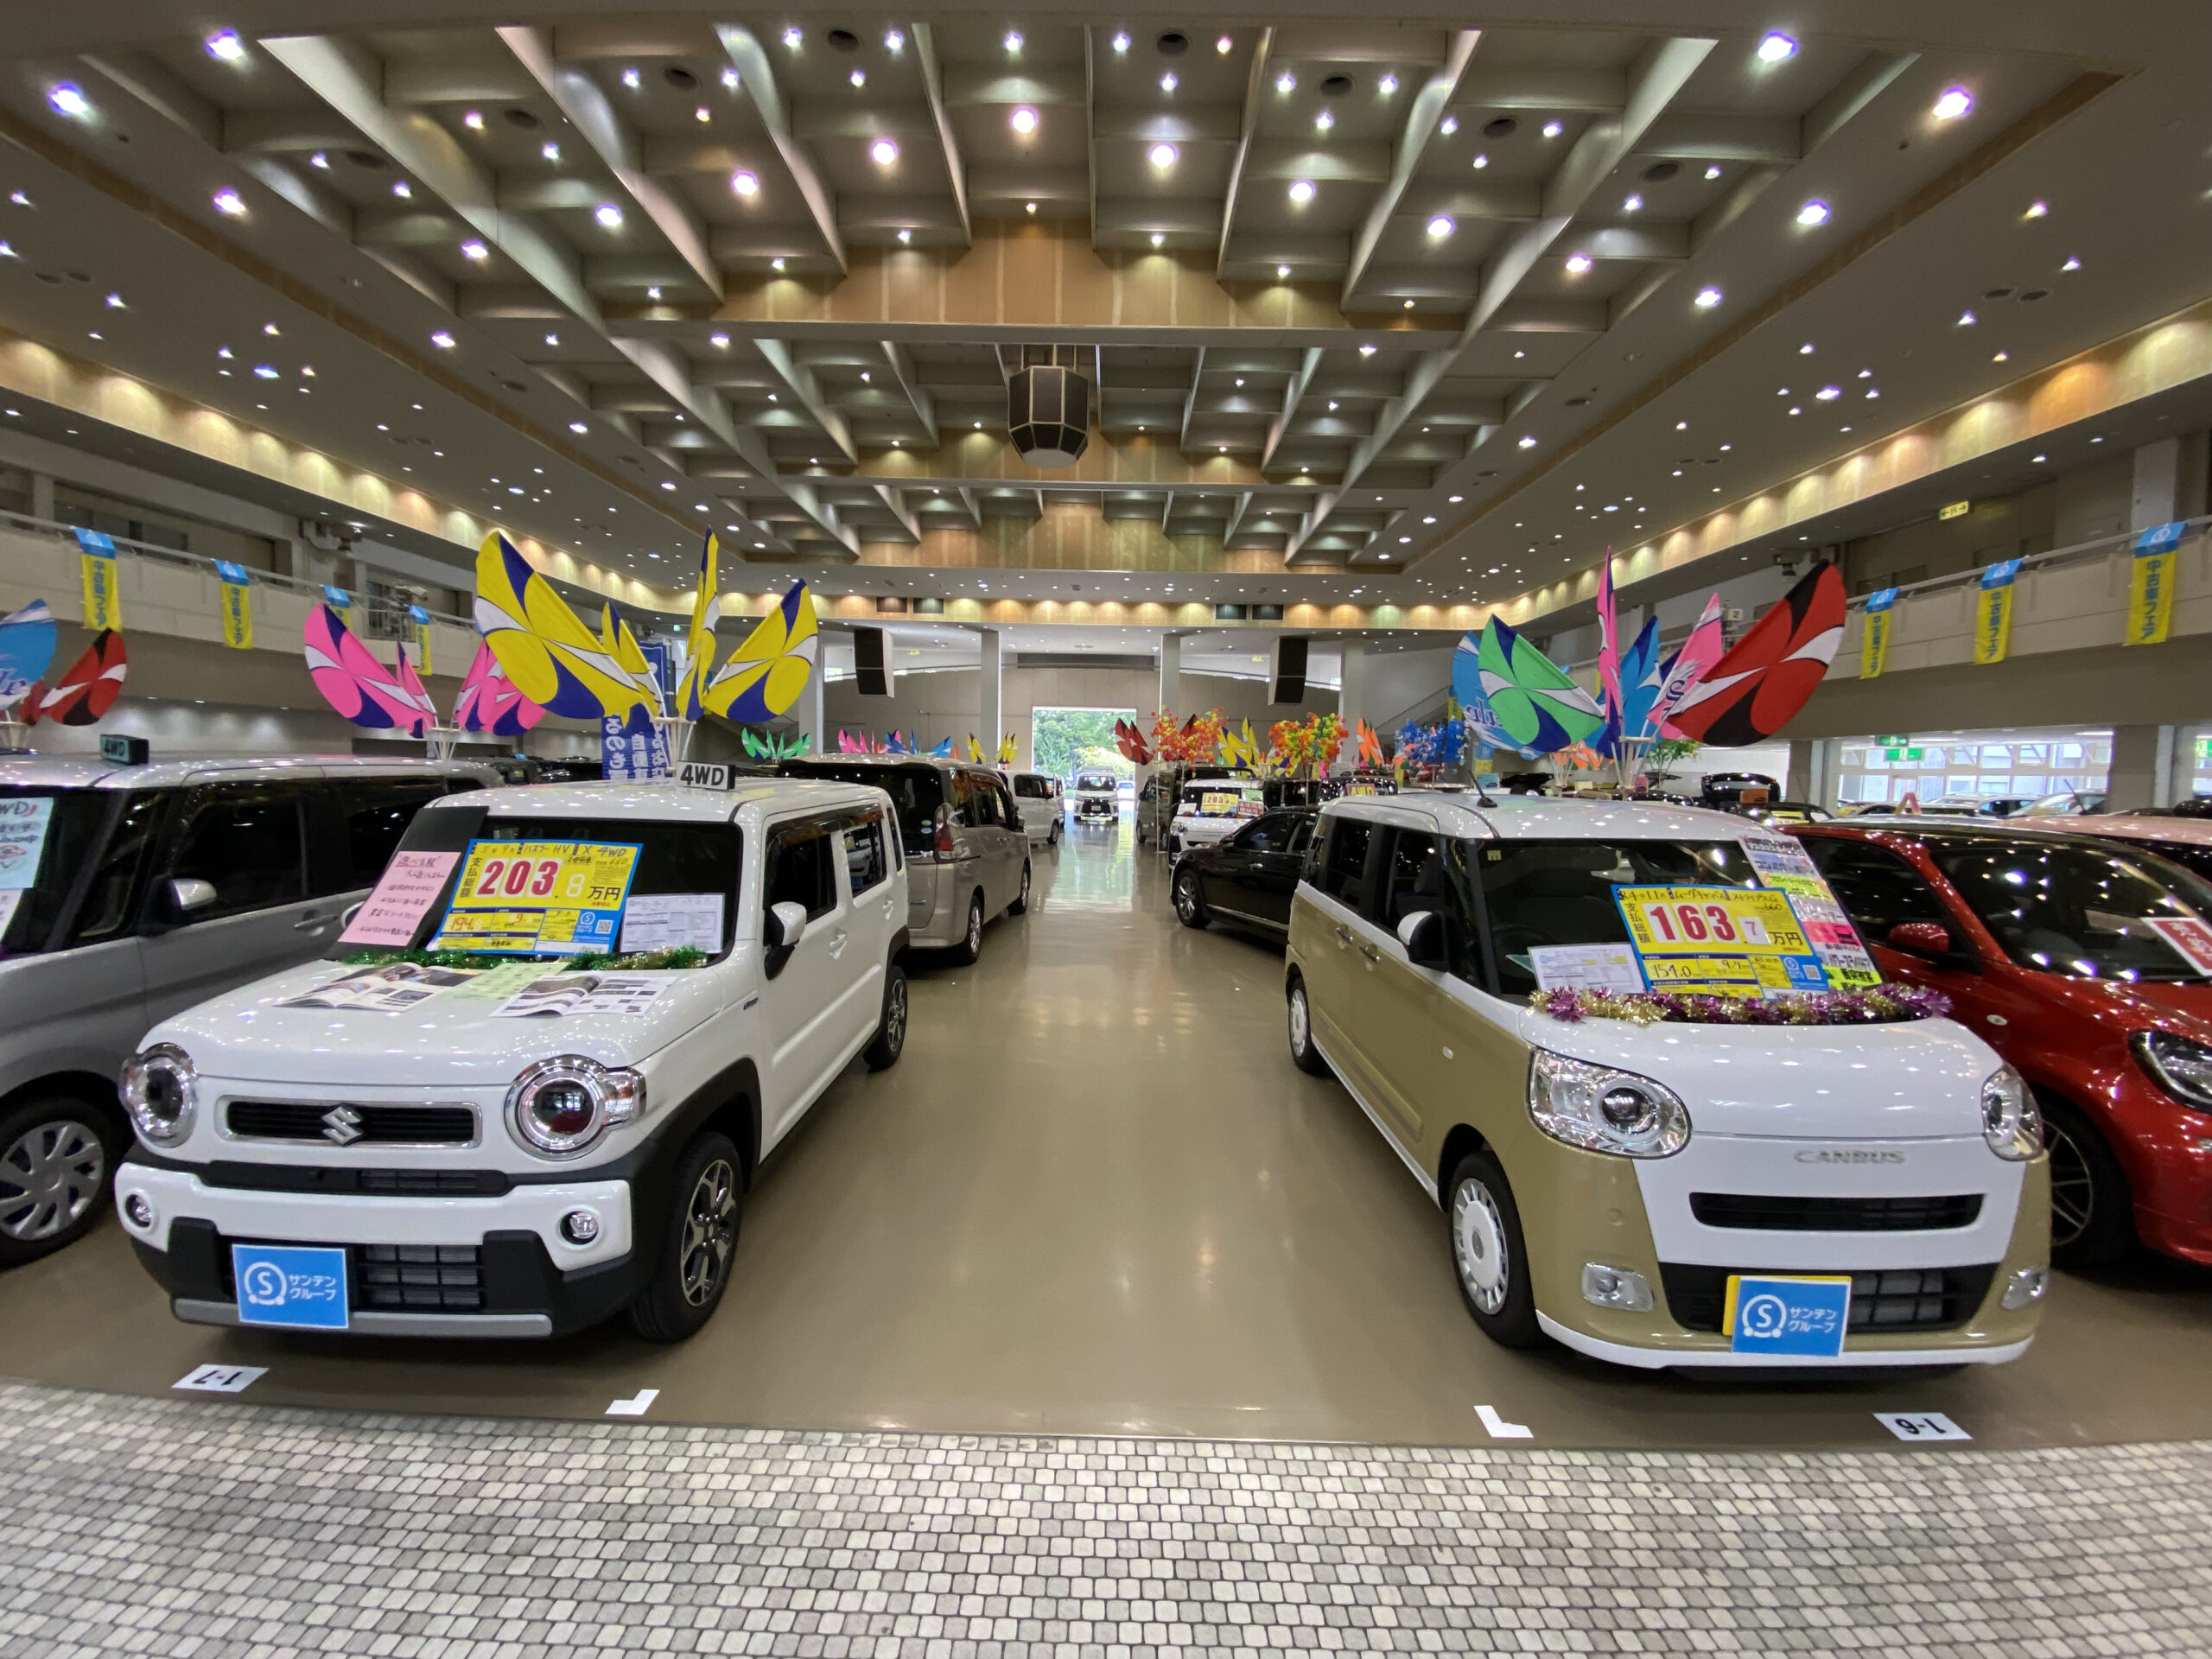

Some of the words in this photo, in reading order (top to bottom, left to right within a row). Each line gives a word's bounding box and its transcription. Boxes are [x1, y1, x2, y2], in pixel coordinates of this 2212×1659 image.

[1732, 610, 1740, 619] 2
[680, 764, 724, 786] 4WD
[553, 844, 569, 855] HV
[582, 845, 591, 855] X
[598, 845, 627, 857] 4WD
[588, 886, 621, 901] 万円
[1625, 903, 1651, 944] 支払総額
[1770, 932, 1803, 946] 万円
[1794, 1149, 1906, 1164] CANBUS
